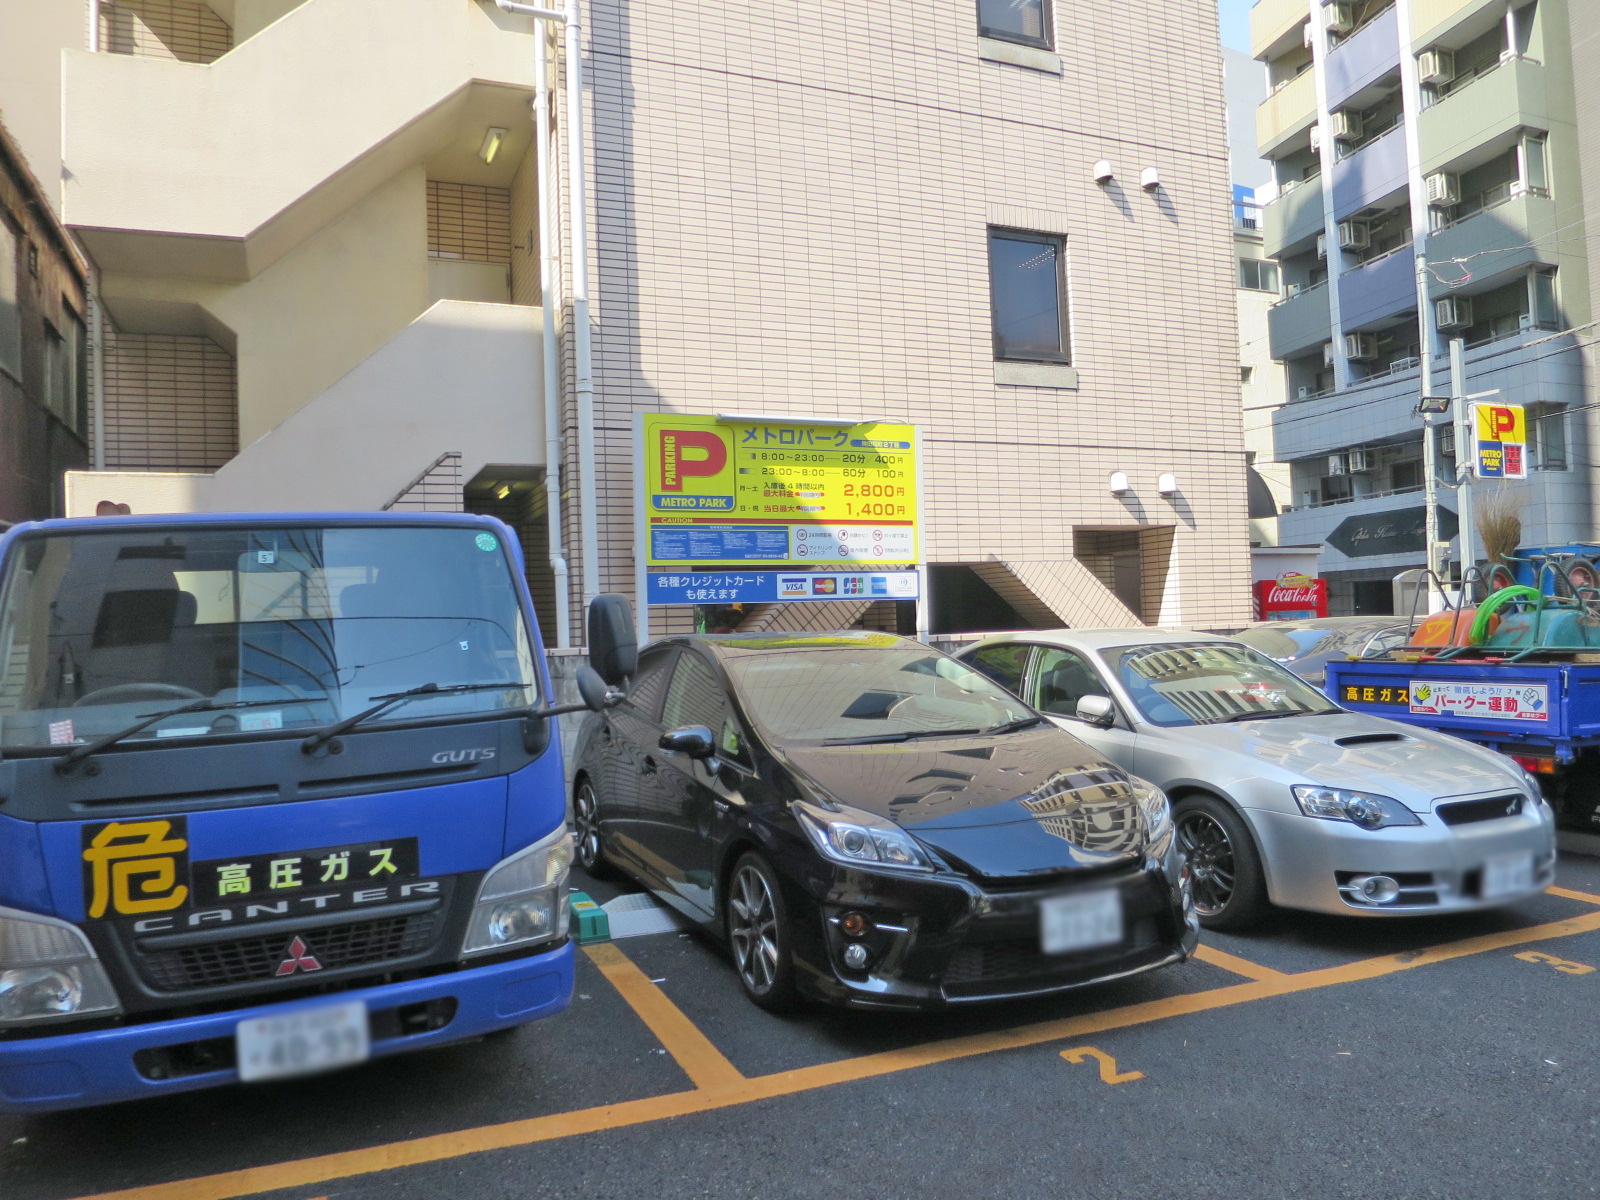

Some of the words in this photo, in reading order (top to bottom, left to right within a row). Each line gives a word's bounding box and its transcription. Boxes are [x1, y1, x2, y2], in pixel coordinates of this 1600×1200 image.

[1490, 407, 1515, 440] P
[741, 427, 849, 447] メトロパーク
[660, 430, 727, 491] P
[664, 435, 676, 486] PARKING
[1480, 449, 1501, 458] METRO
[1483, 458, 1500, 466] PARK
[763, 490, 794, 498] 最大料金
[844, 484, 905, 498] 2,800円
[661, 497, 696, 507] METRO
[699, 498, 727, 507] PARK
[763, 505, 795, 513] 当日最大
[846, 503, 905, 516] 1,400円
[658, 575, 764, 588] 各種クレジットカード
[686, 589, 739, 600] も使えます
[1346, 686, 1409, 703] 高圧ガス
[1434, 694, 1518, 712] パー・グー運動
[431, 748, 496, 764] GUTS
[82, 820, 189, 918] 危
[217, 848, 398, 896] 高圧ガス
[134, 881, 441, 933] CANTER
[1513, 950, 1598, 975] 3
[1059, 1046, 1146, 1085] 2
